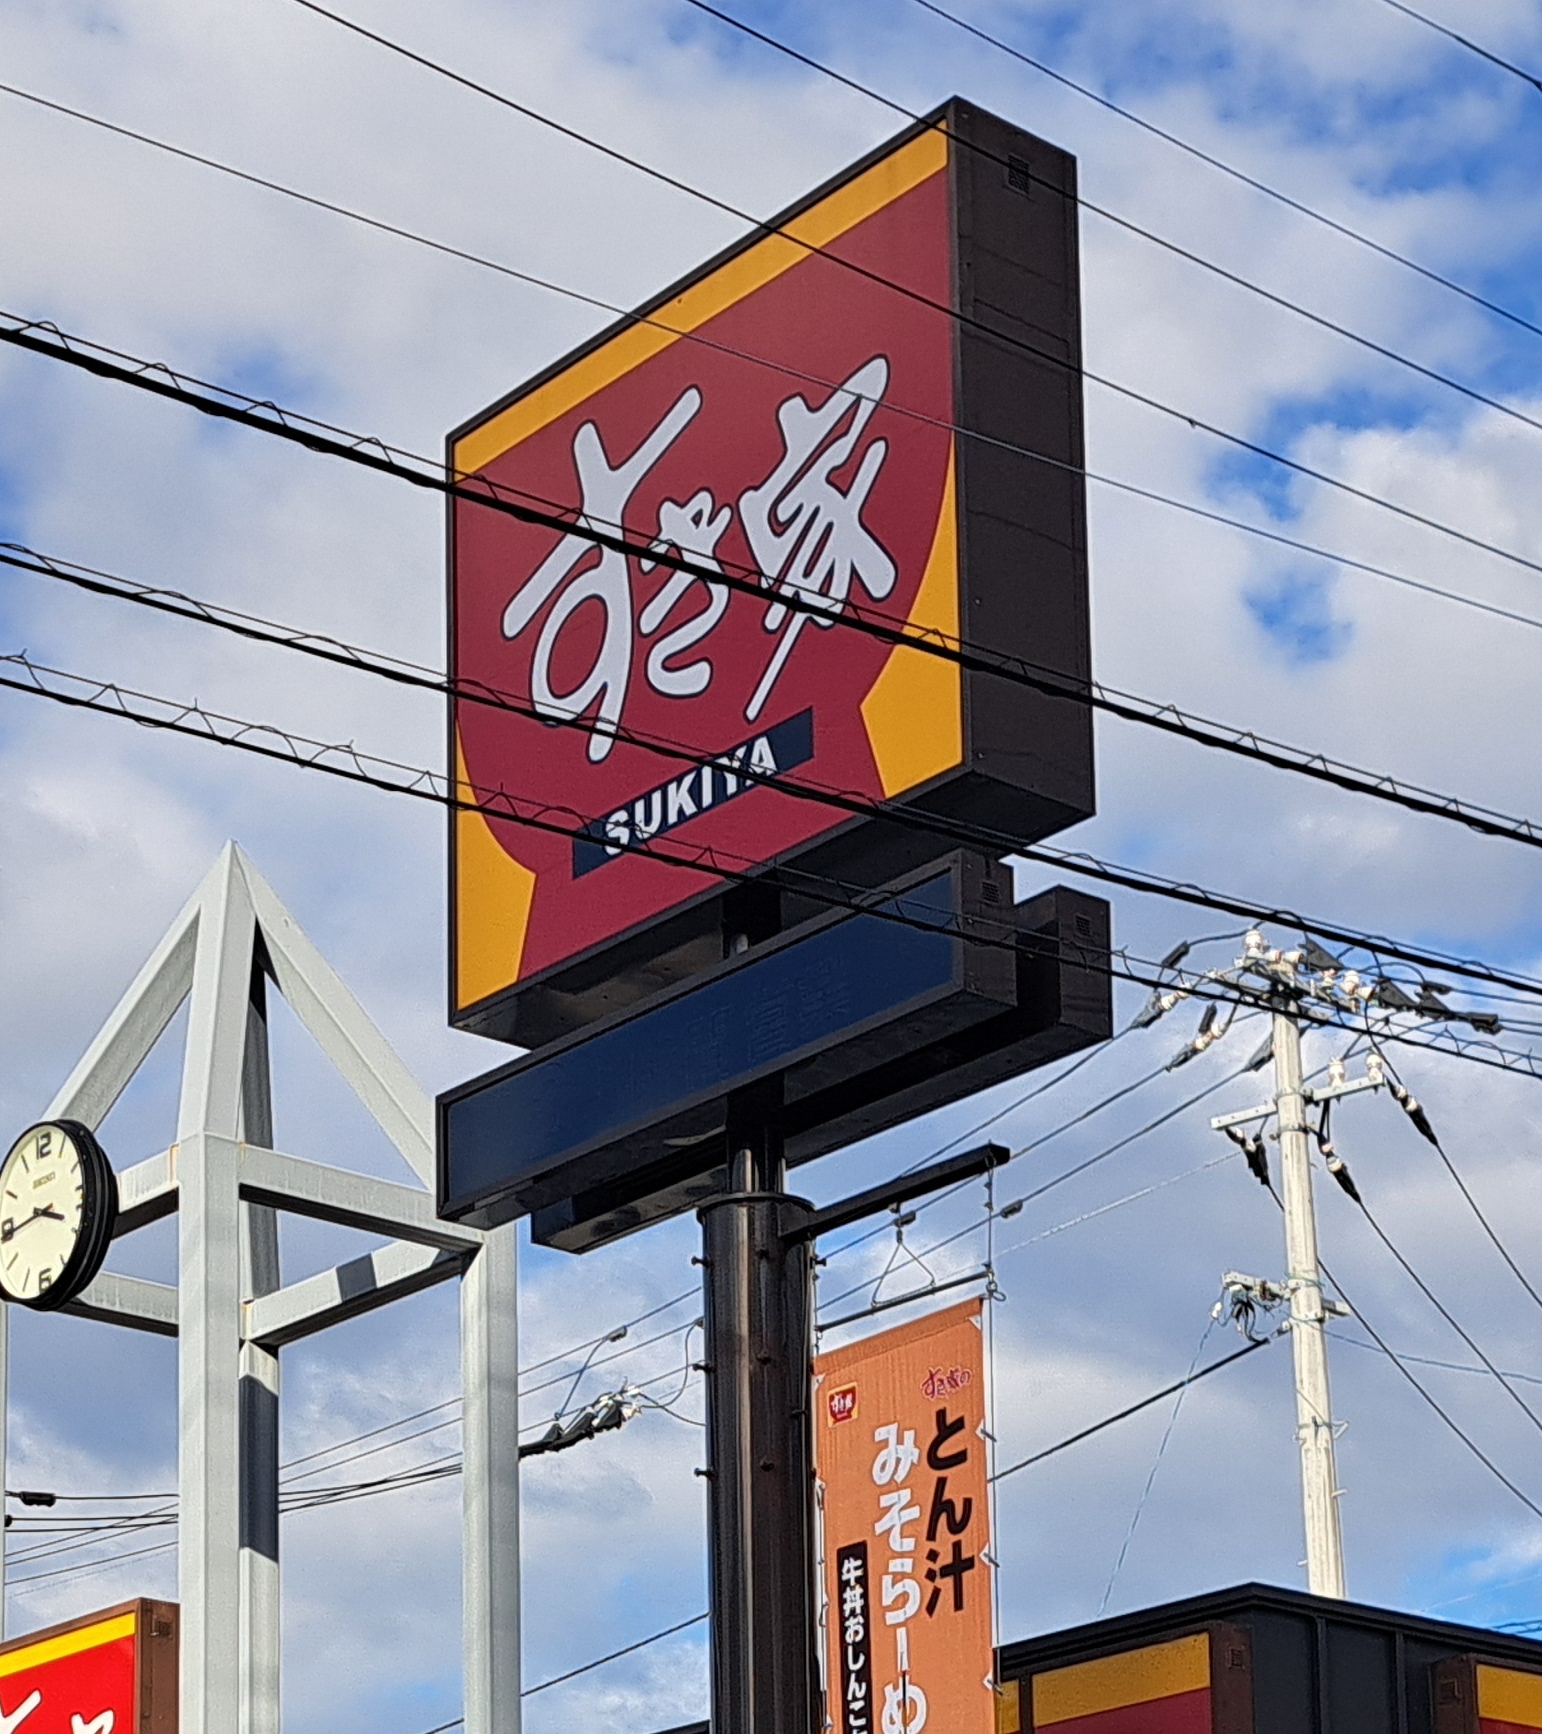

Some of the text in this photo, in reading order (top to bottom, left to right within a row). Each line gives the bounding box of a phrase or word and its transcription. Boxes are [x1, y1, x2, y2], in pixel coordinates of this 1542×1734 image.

[502, 354, 896, 763] すき家
[604, 733, 778, 857] SUKIYA
[35, 1131, 52, 1160] 12
[924, 1406, 976, 1619] とん汁
